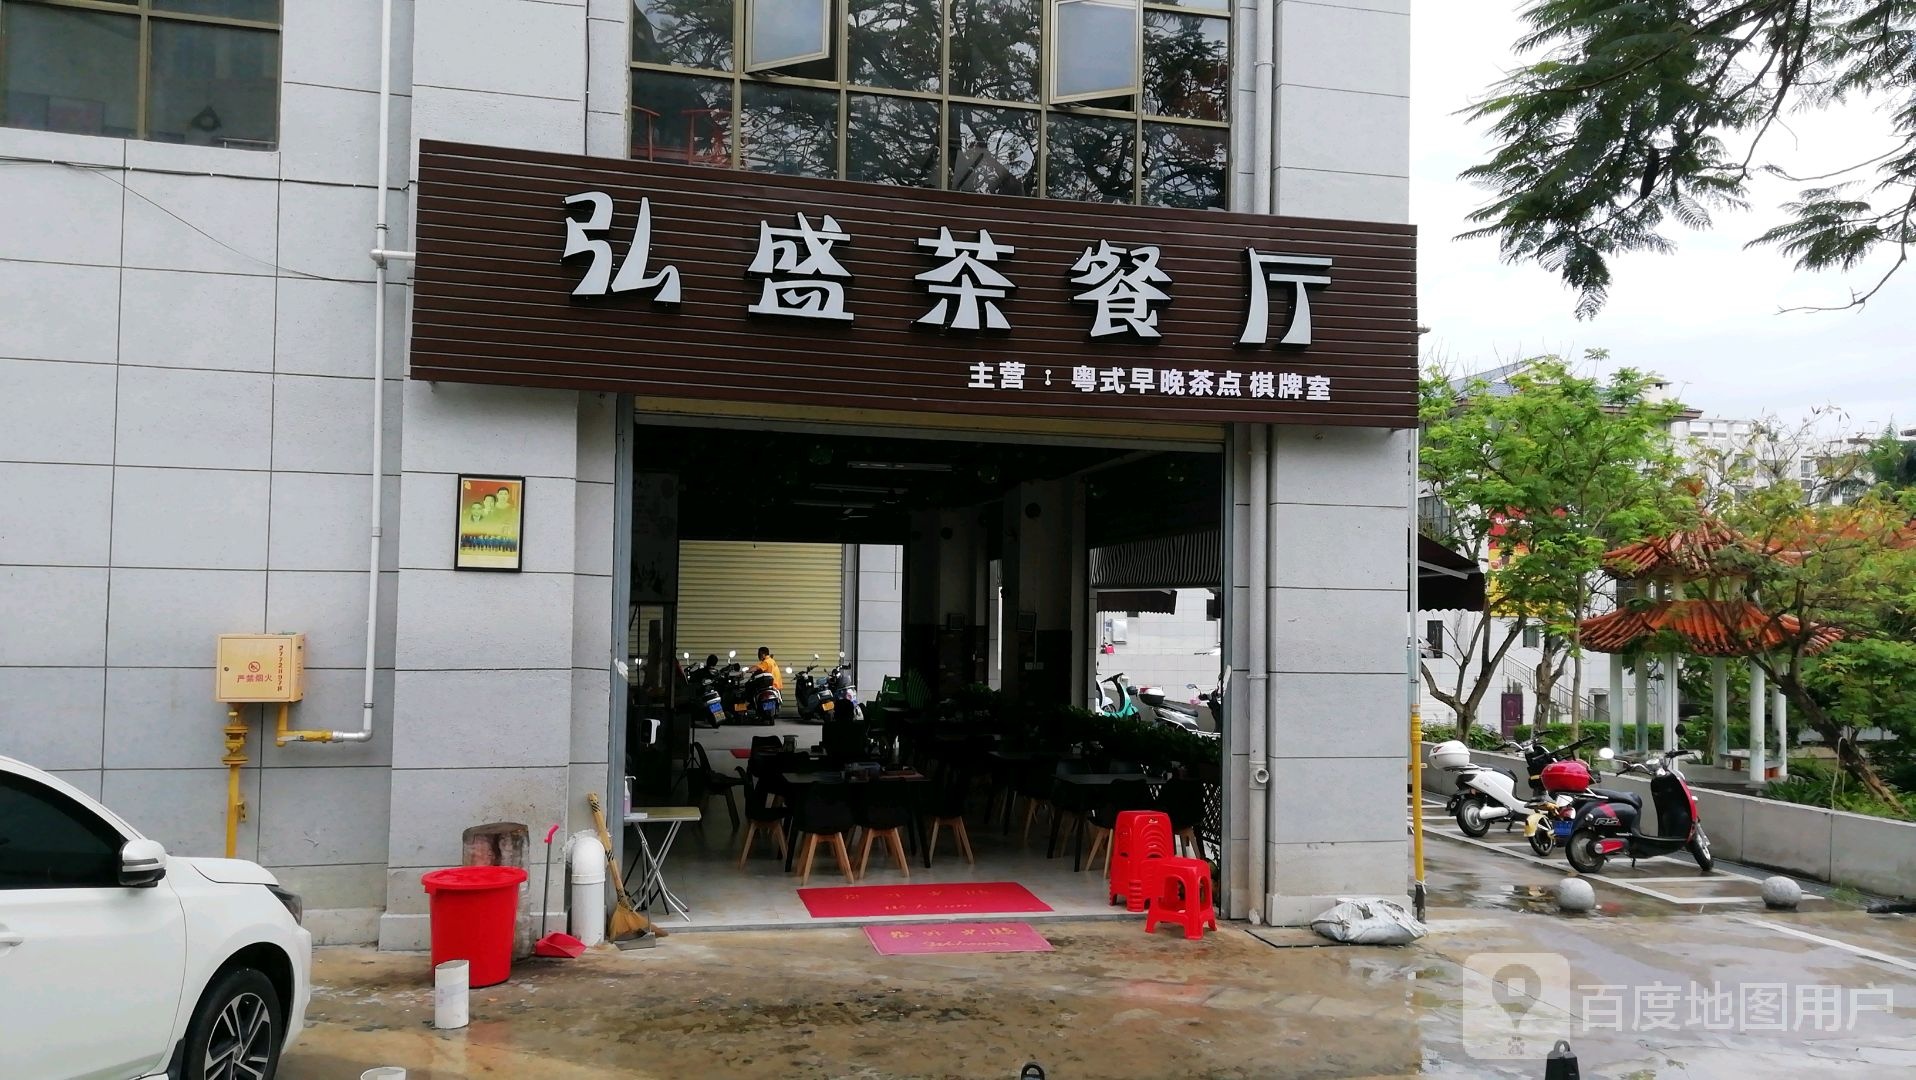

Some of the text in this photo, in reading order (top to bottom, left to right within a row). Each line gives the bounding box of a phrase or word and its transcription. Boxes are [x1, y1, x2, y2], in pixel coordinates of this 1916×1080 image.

[563, 191, 1334, 346] 弘盛茶餐厅
[237, 673, 273, 684] 严禁烟火
